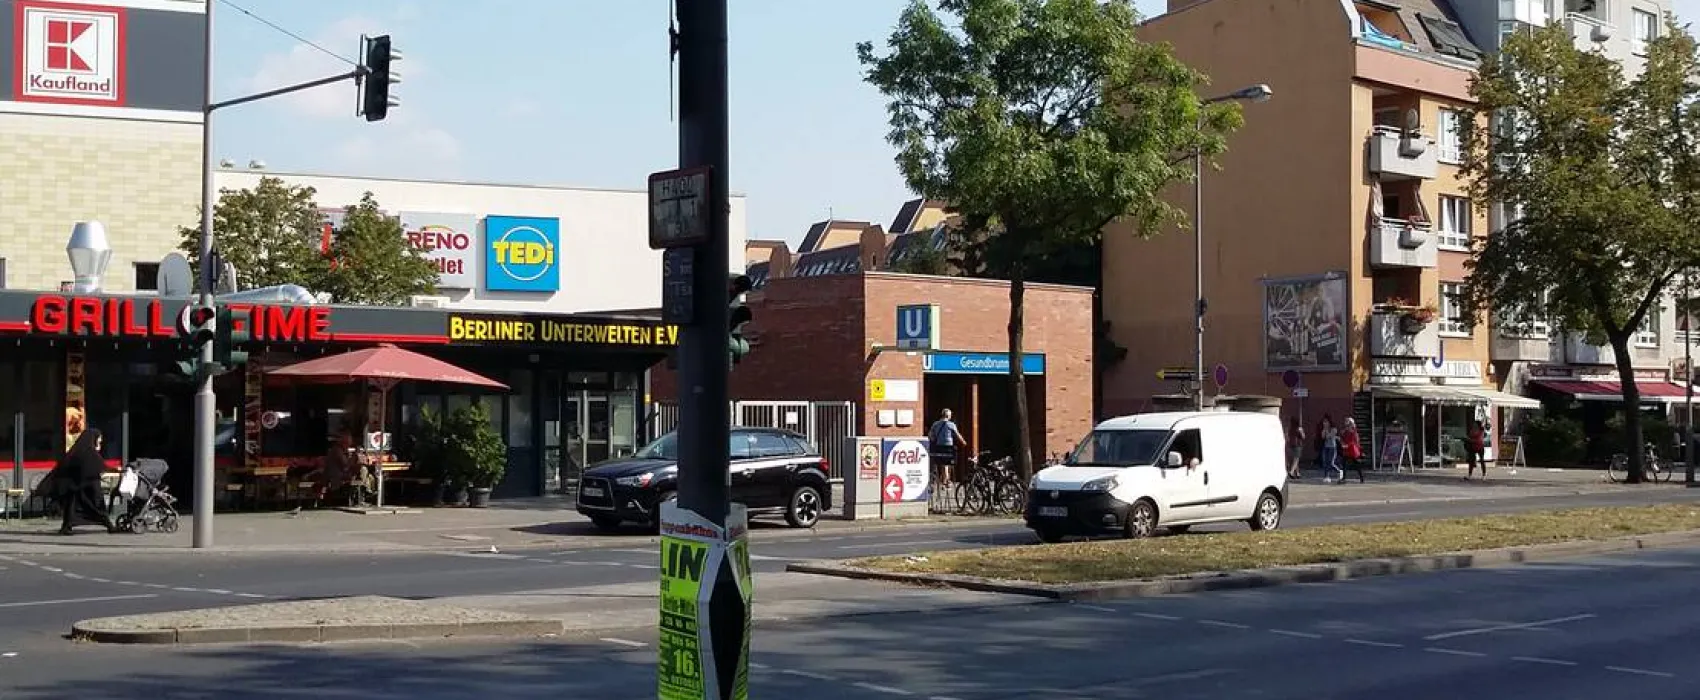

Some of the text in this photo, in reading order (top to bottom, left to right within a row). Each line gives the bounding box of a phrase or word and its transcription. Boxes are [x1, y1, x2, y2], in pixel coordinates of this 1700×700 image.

[29, 74, 111, 93] Kaufland
[406, 231, 469, 250] RENO
[32, 295, 176, 337] GRILL
[904, 308, 923, 337] U
[451, 316, 535, 341] BERLINER
[541, 320, 651, 345] UNTERWELTEN
[923, 354, 1010, 371] U Gesundbrunn
